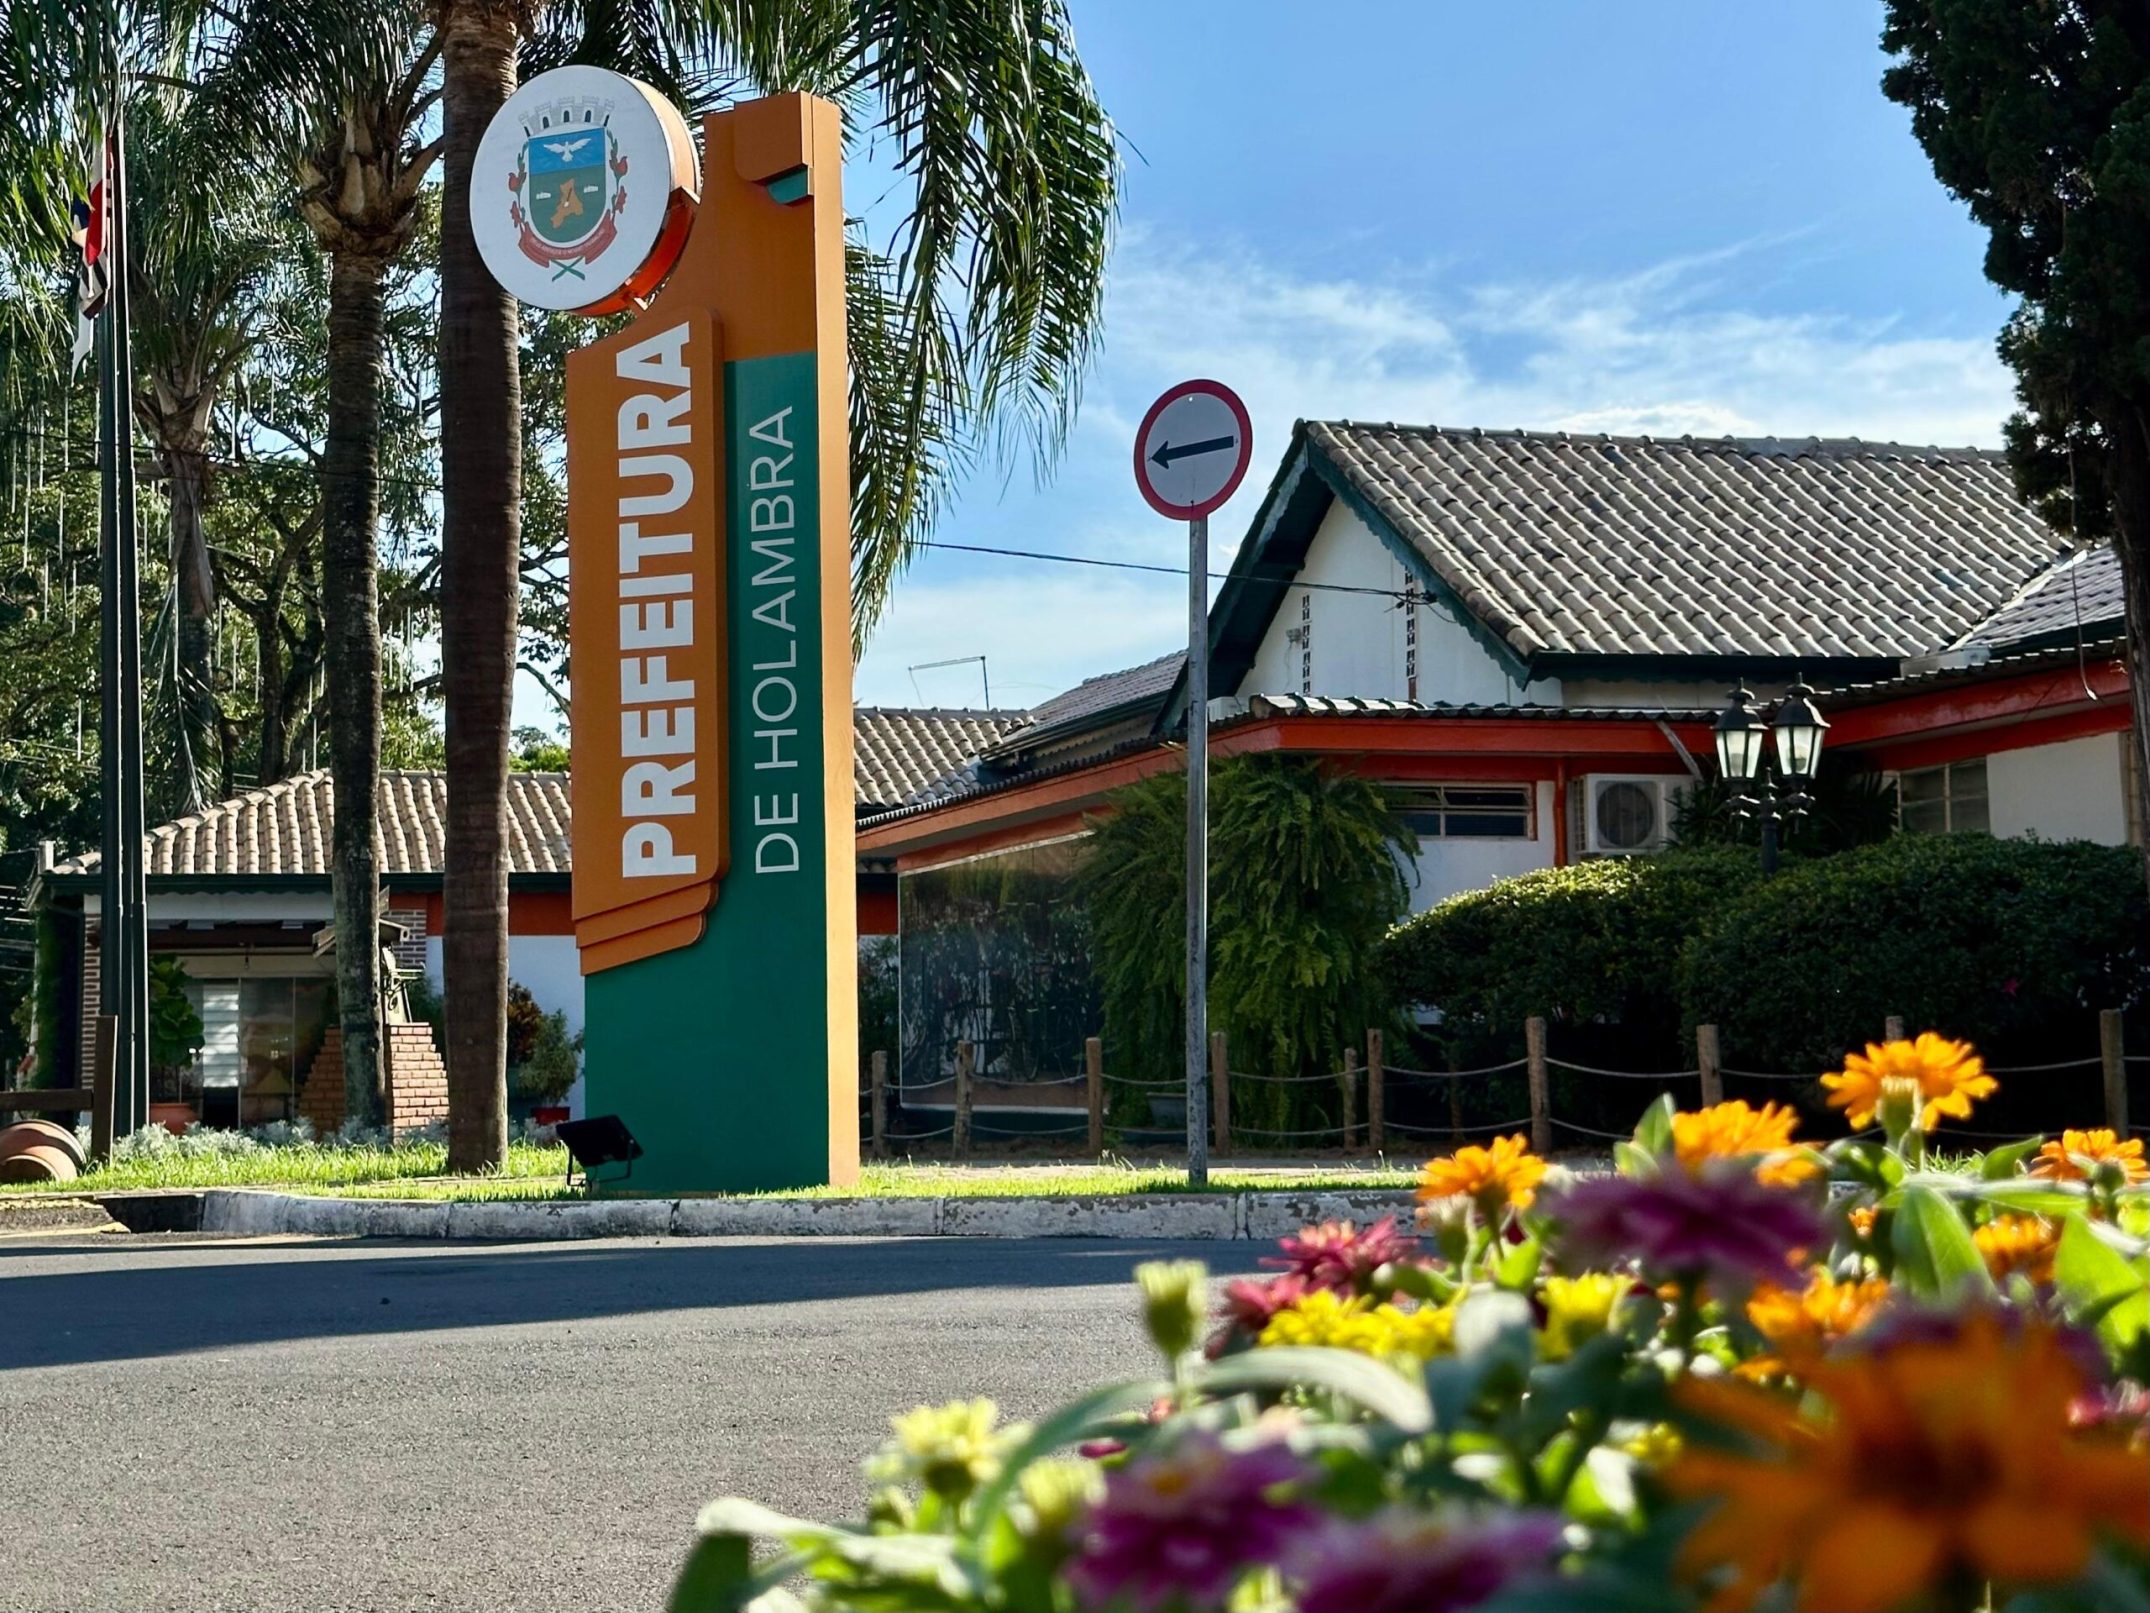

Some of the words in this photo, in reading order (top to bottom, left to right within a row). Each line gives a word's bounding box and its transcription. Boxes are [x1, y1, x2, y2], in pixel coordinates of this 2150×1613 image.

[616, 321, 696, 878] PREFEITURA
[749, 406, 799, 770] HOLAMBRA
[755, 792, 799, 873] DE
